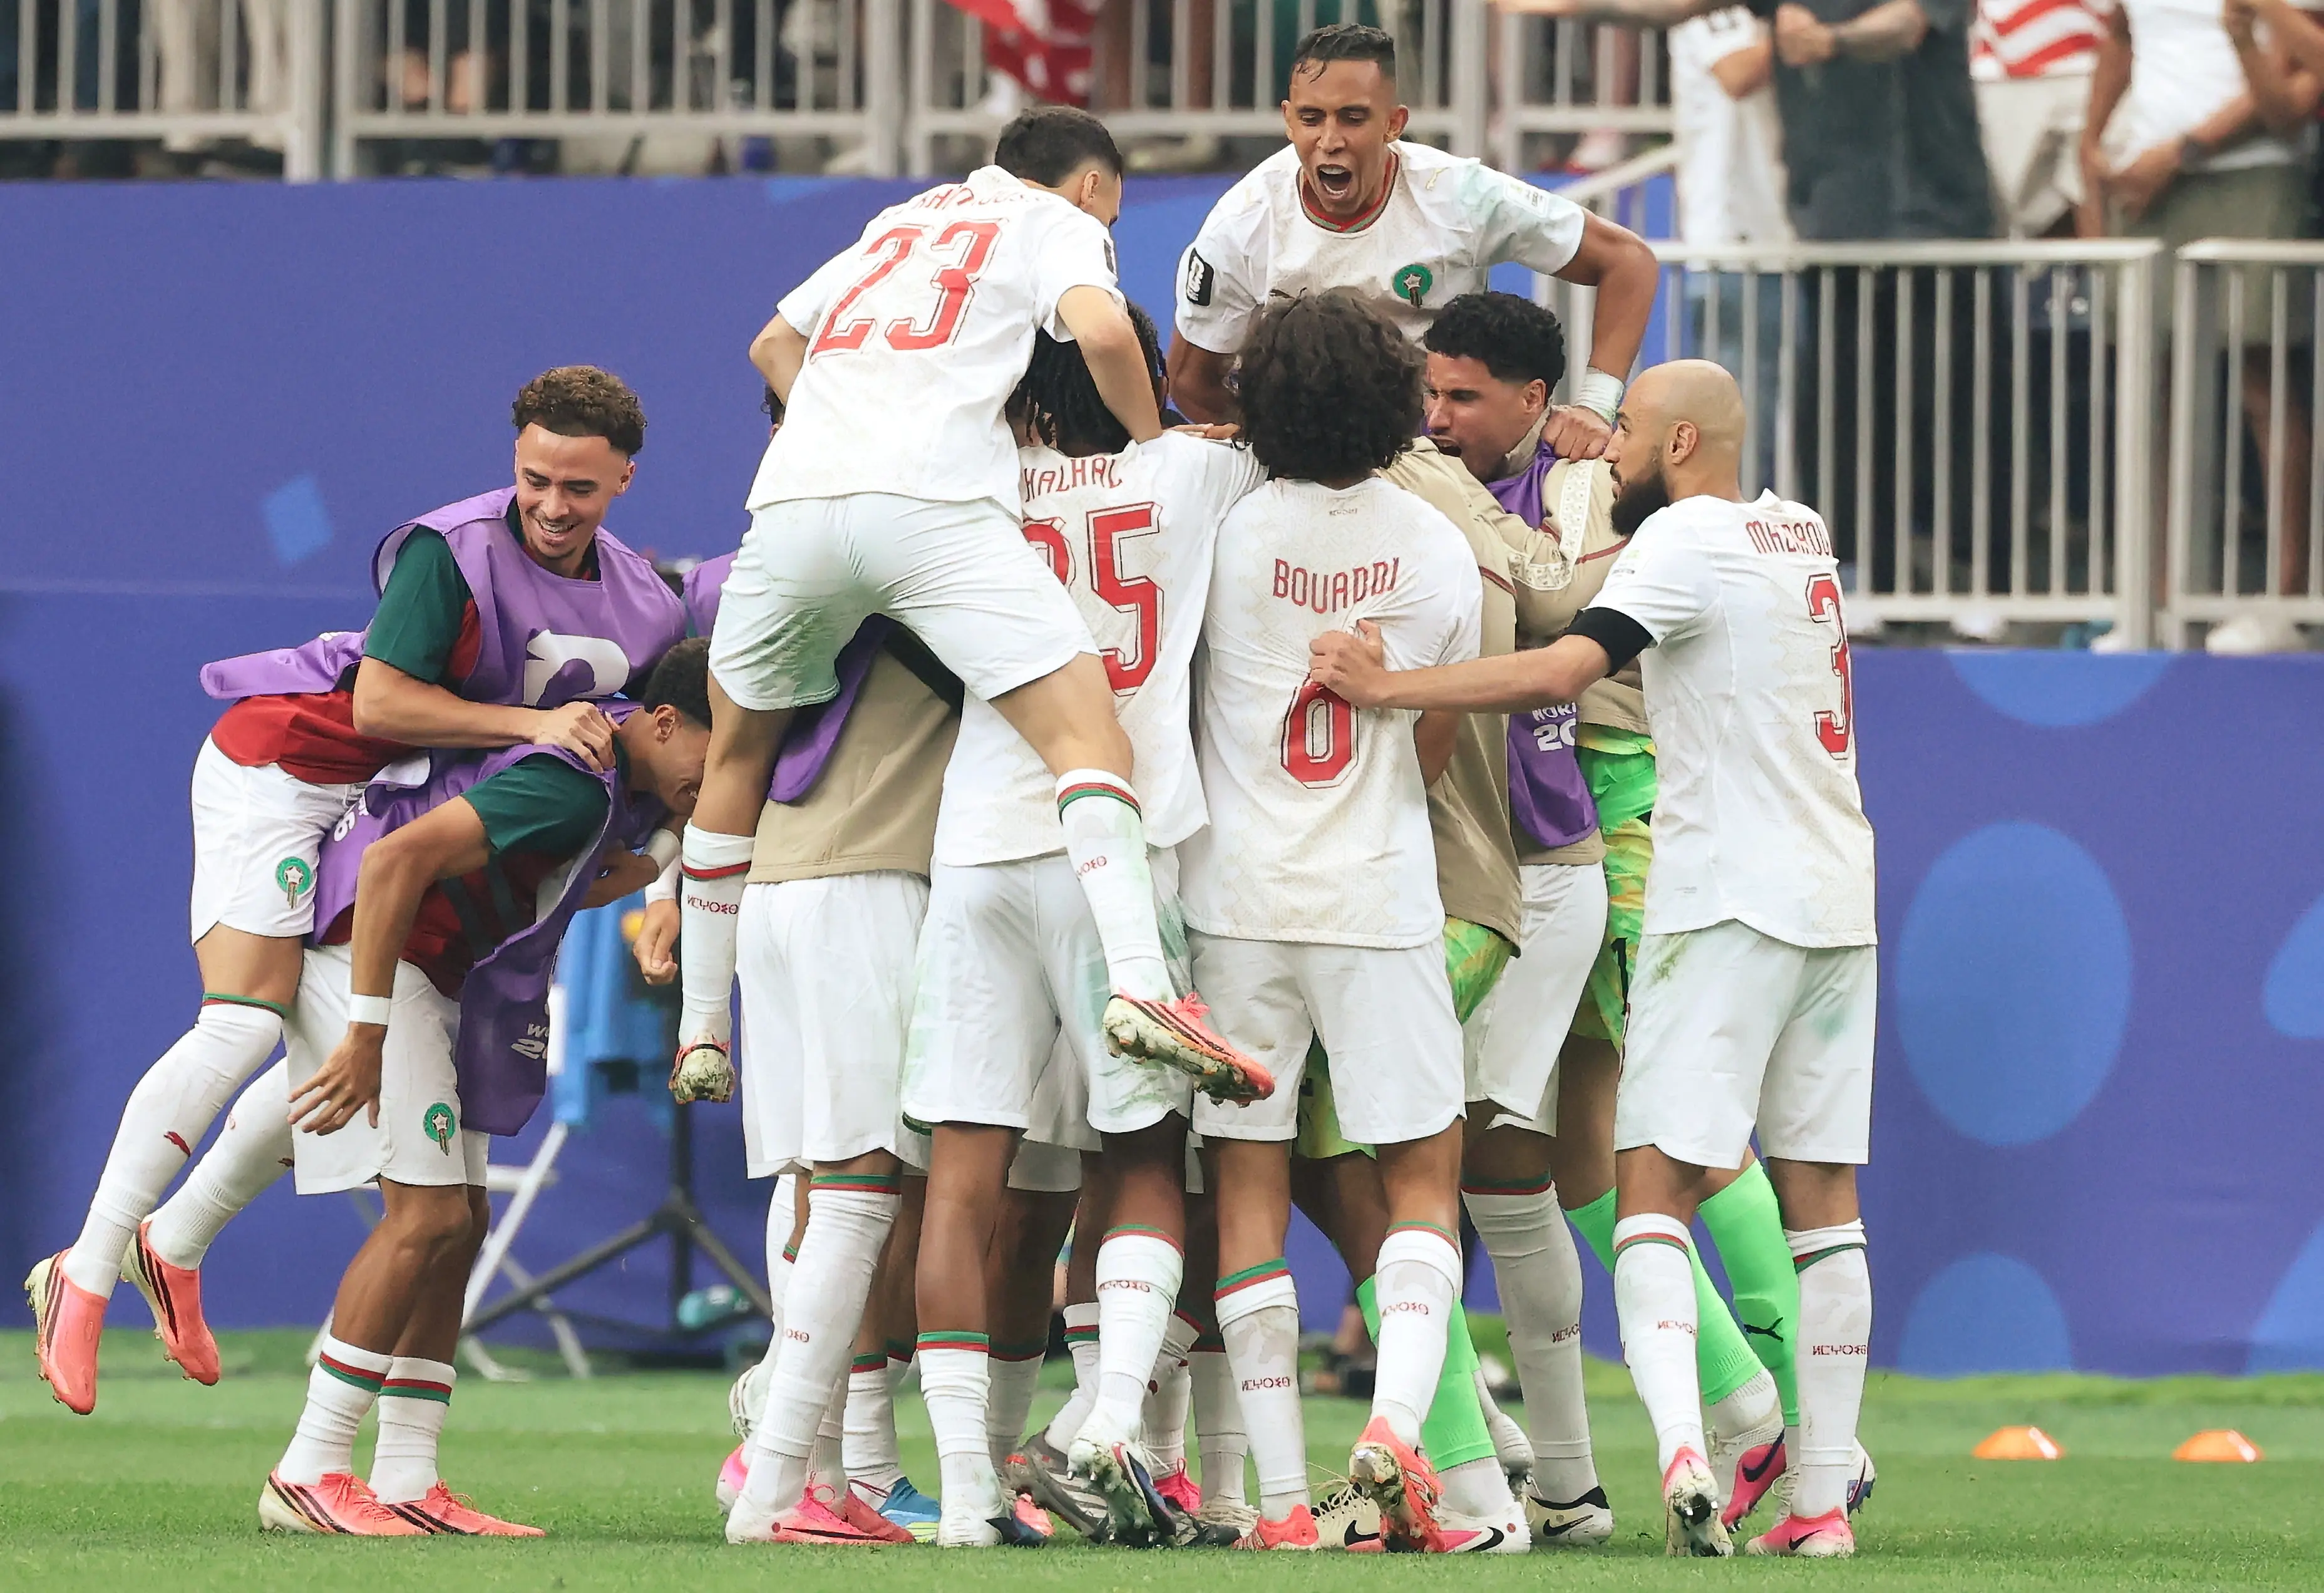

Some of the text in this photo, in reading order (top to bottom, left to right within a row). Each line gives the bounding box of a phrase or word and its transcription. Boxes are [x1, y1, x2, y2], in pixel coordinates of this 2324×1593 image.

[810, 217, 1009, 364] 23
[1024, 457, 1123, 503] HALHAL
[1273, 557, 1400, 614] BOUADDI
[1806, 572, 1852, 760] 3
